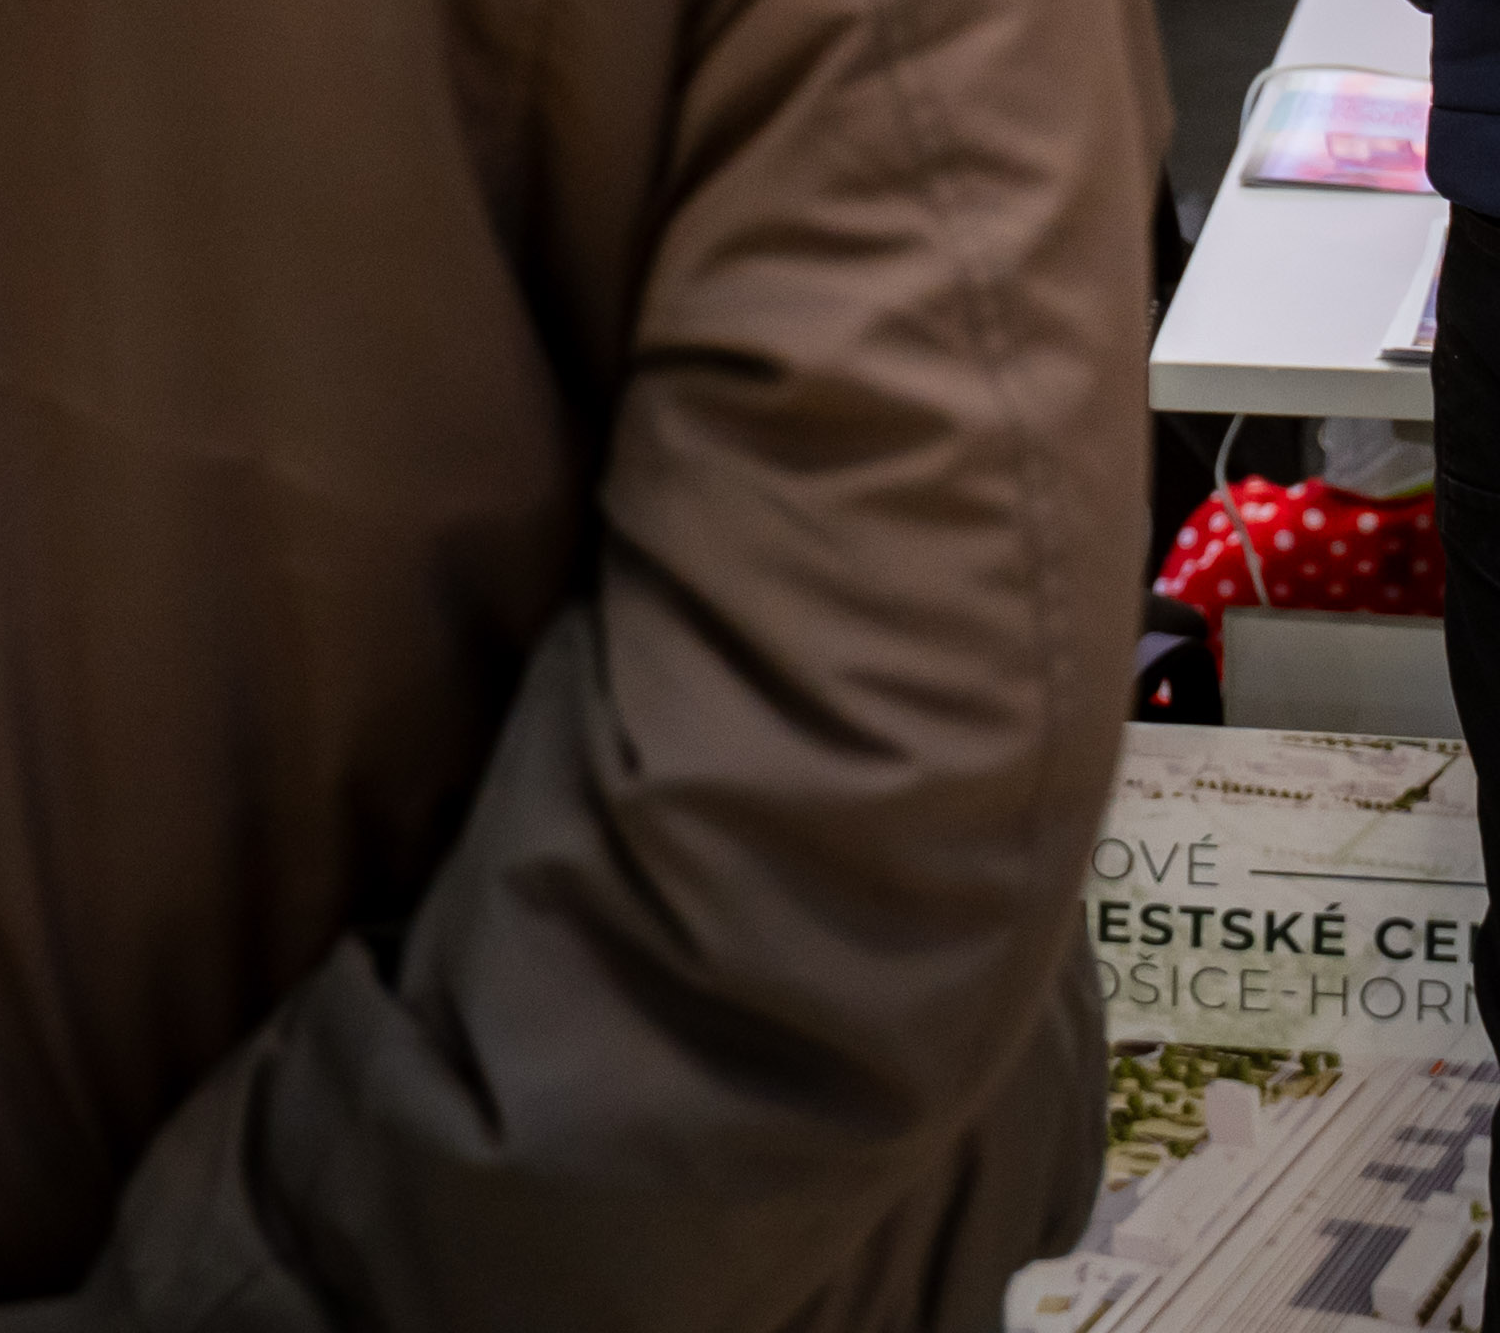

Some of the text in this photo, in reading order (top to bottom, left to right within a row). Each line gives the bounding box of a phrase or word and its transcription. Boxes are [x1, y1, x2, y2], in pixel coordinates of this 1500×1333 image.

[1092, 834, 1220, 886] OVÉ
[1098, 900, 1480, 965] ESTSKÉ CE
